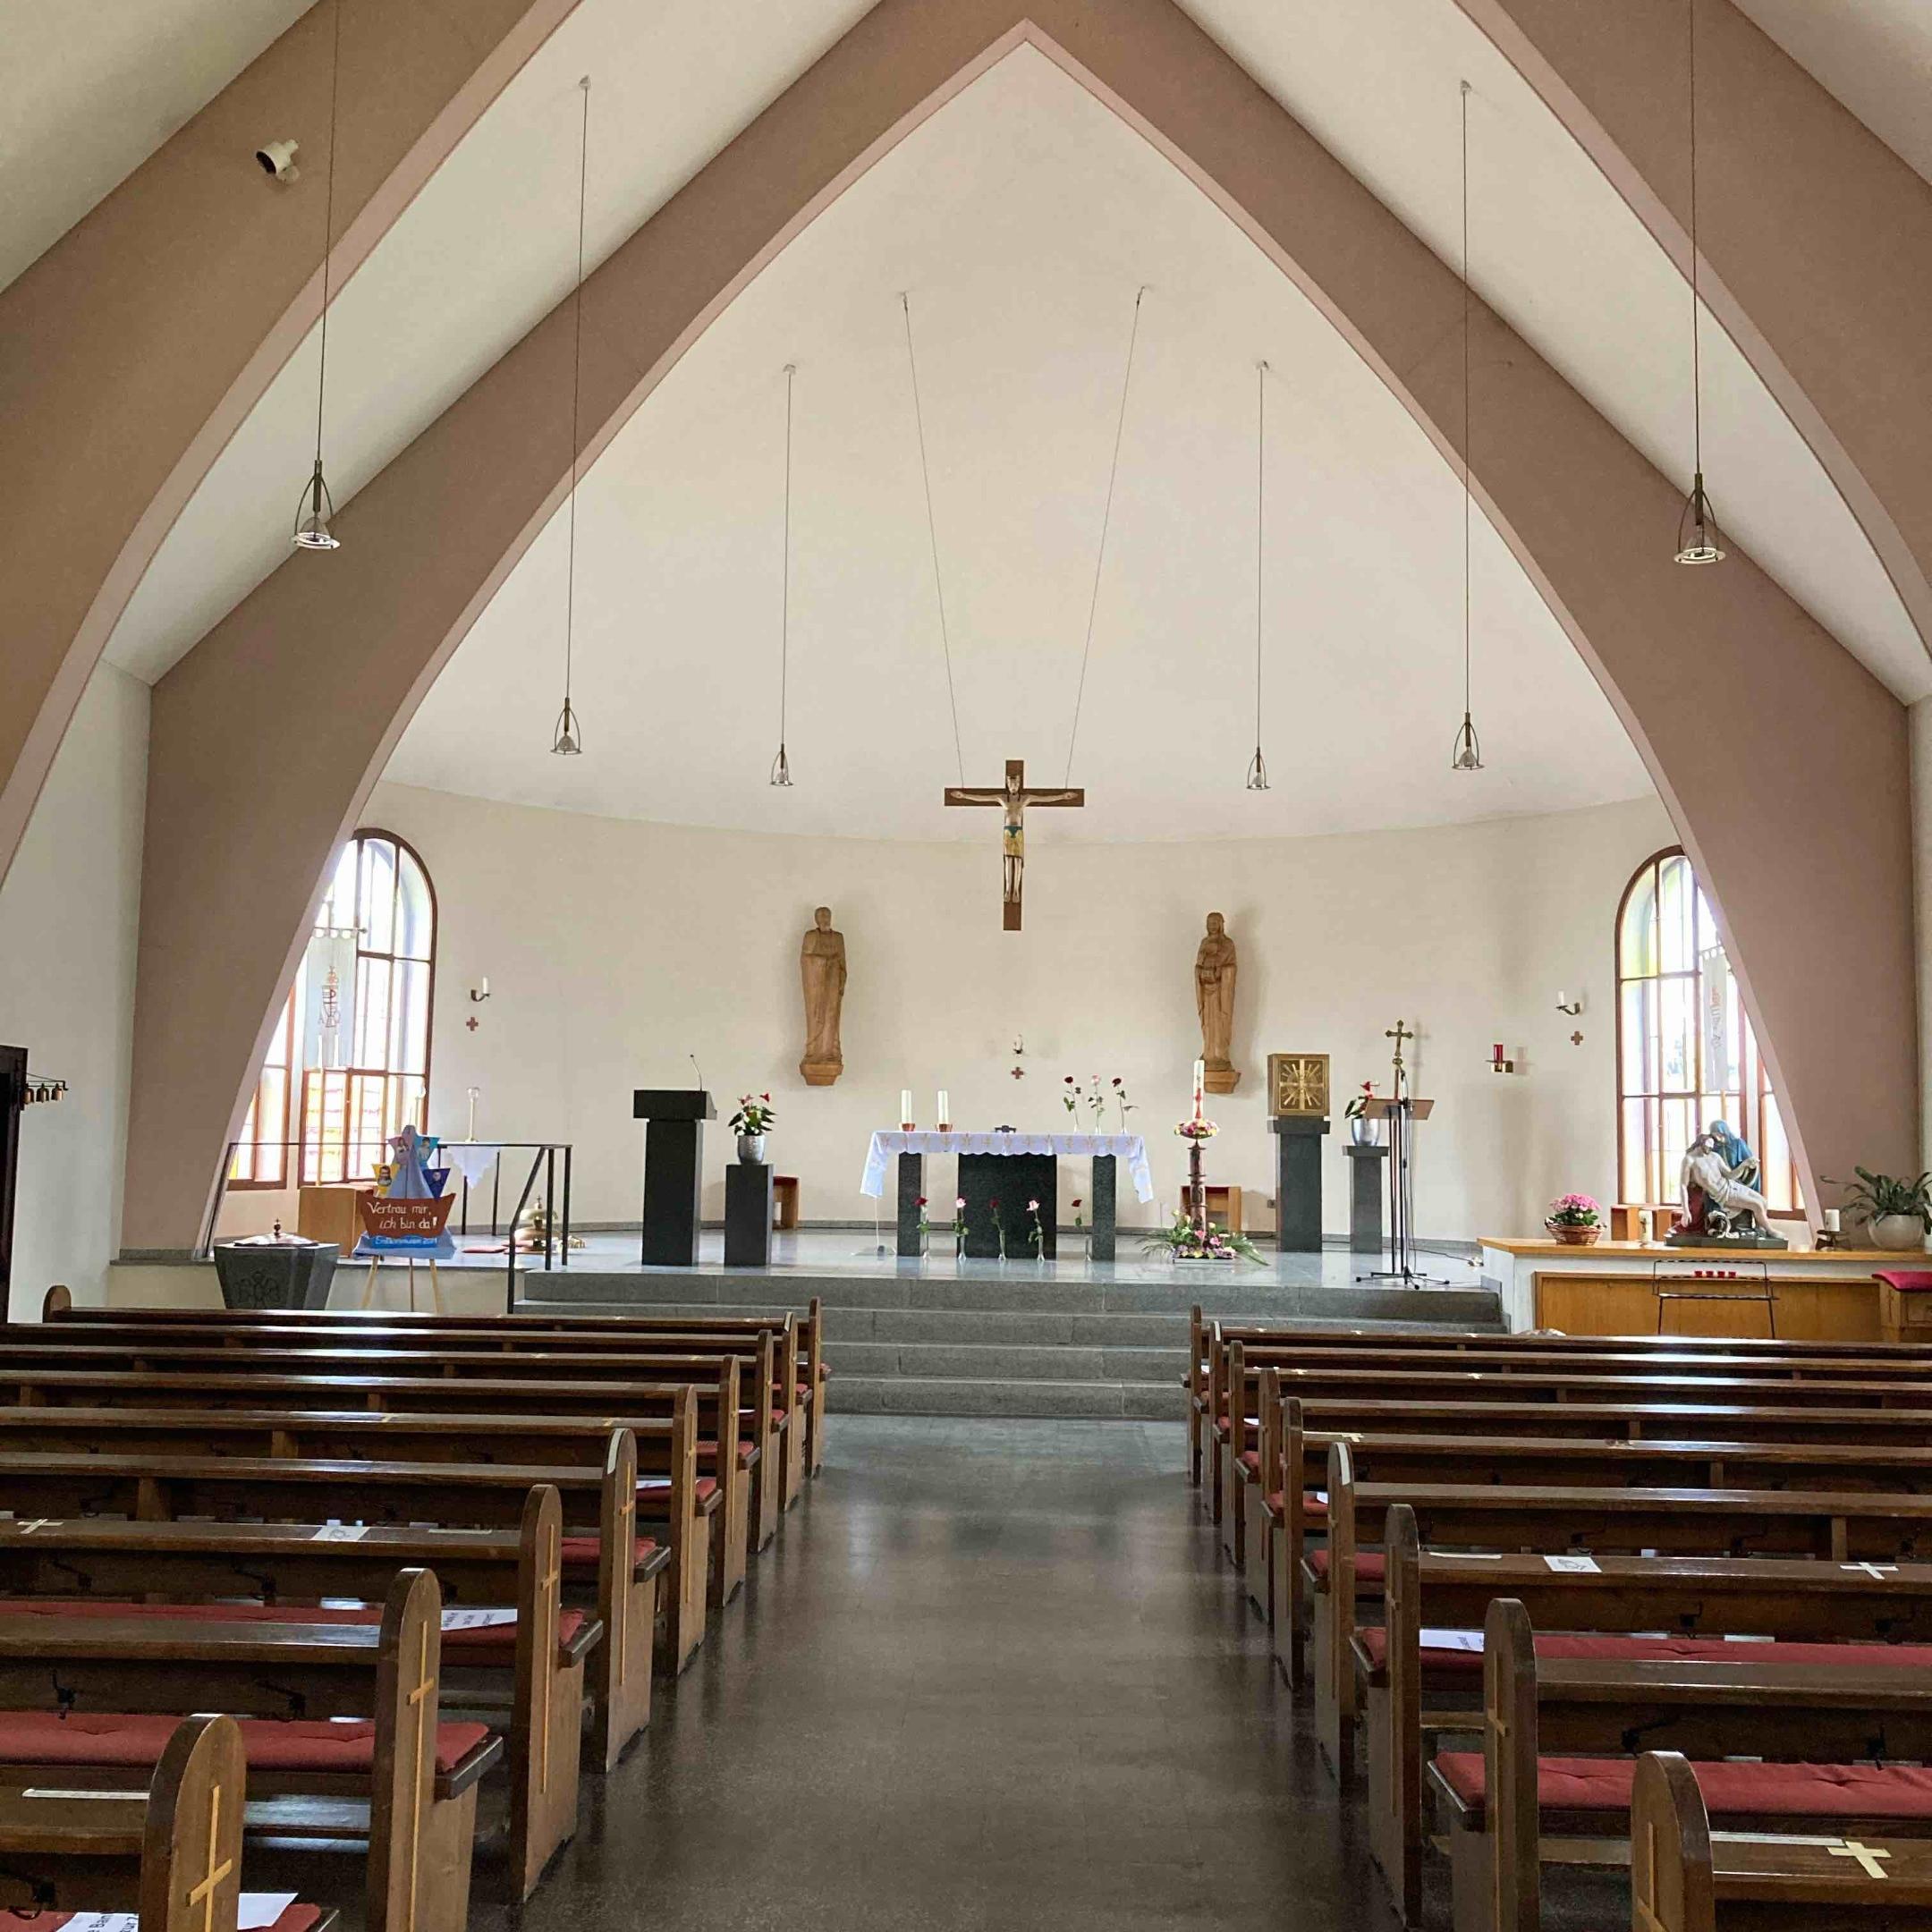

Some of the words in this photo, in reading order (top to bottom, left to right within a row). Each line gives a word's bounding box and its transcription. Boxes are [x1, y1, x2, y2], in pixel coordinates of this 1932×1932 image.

[367, 1201, 406, 1215] Vertrau
[379, 1216, 396, 1229] ich
[400, 1216, 415, 1229] bin
